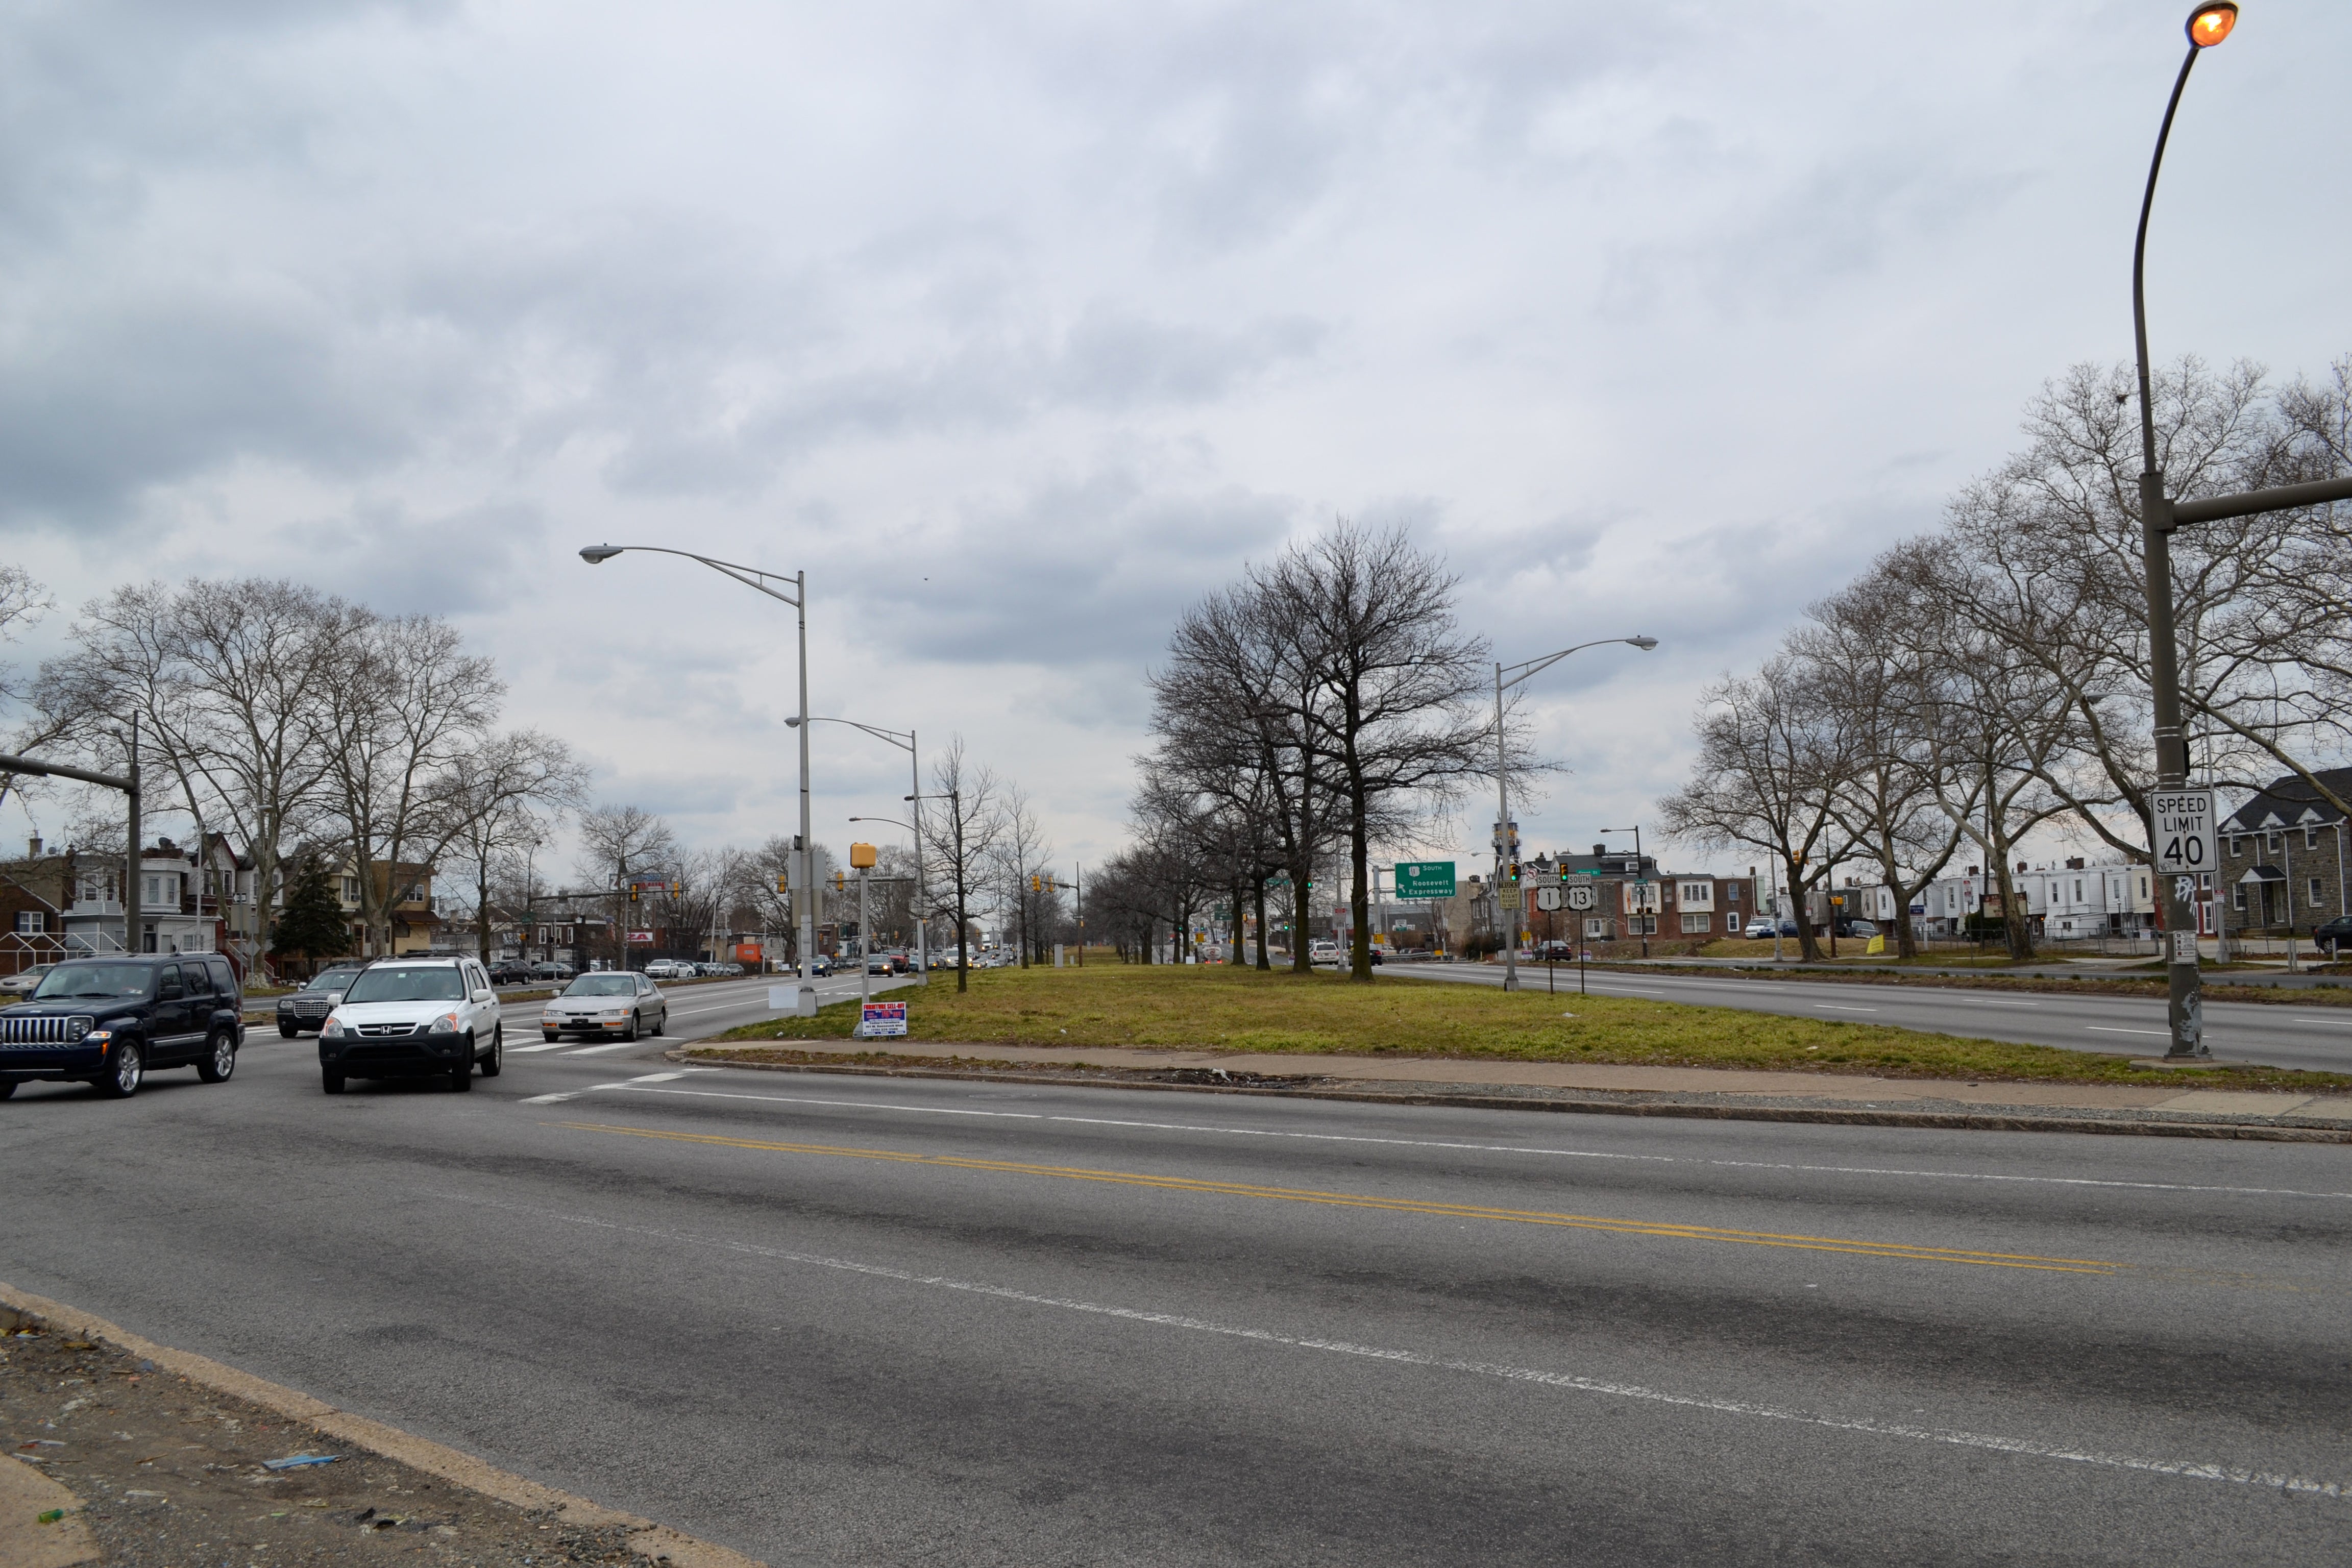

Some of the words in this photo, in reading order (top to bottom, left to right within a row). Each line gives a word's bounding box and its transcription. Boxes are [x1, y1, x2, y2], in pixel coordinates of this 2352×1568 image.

[2157, 797, 2207, 814] SPEED
[2164, 816, 2203, 832] LIMIT
[2164, 836, 2203, 866] 40
[1547, 892, 1551, 905] 1
[1573, 892, 1587, 905] 13
